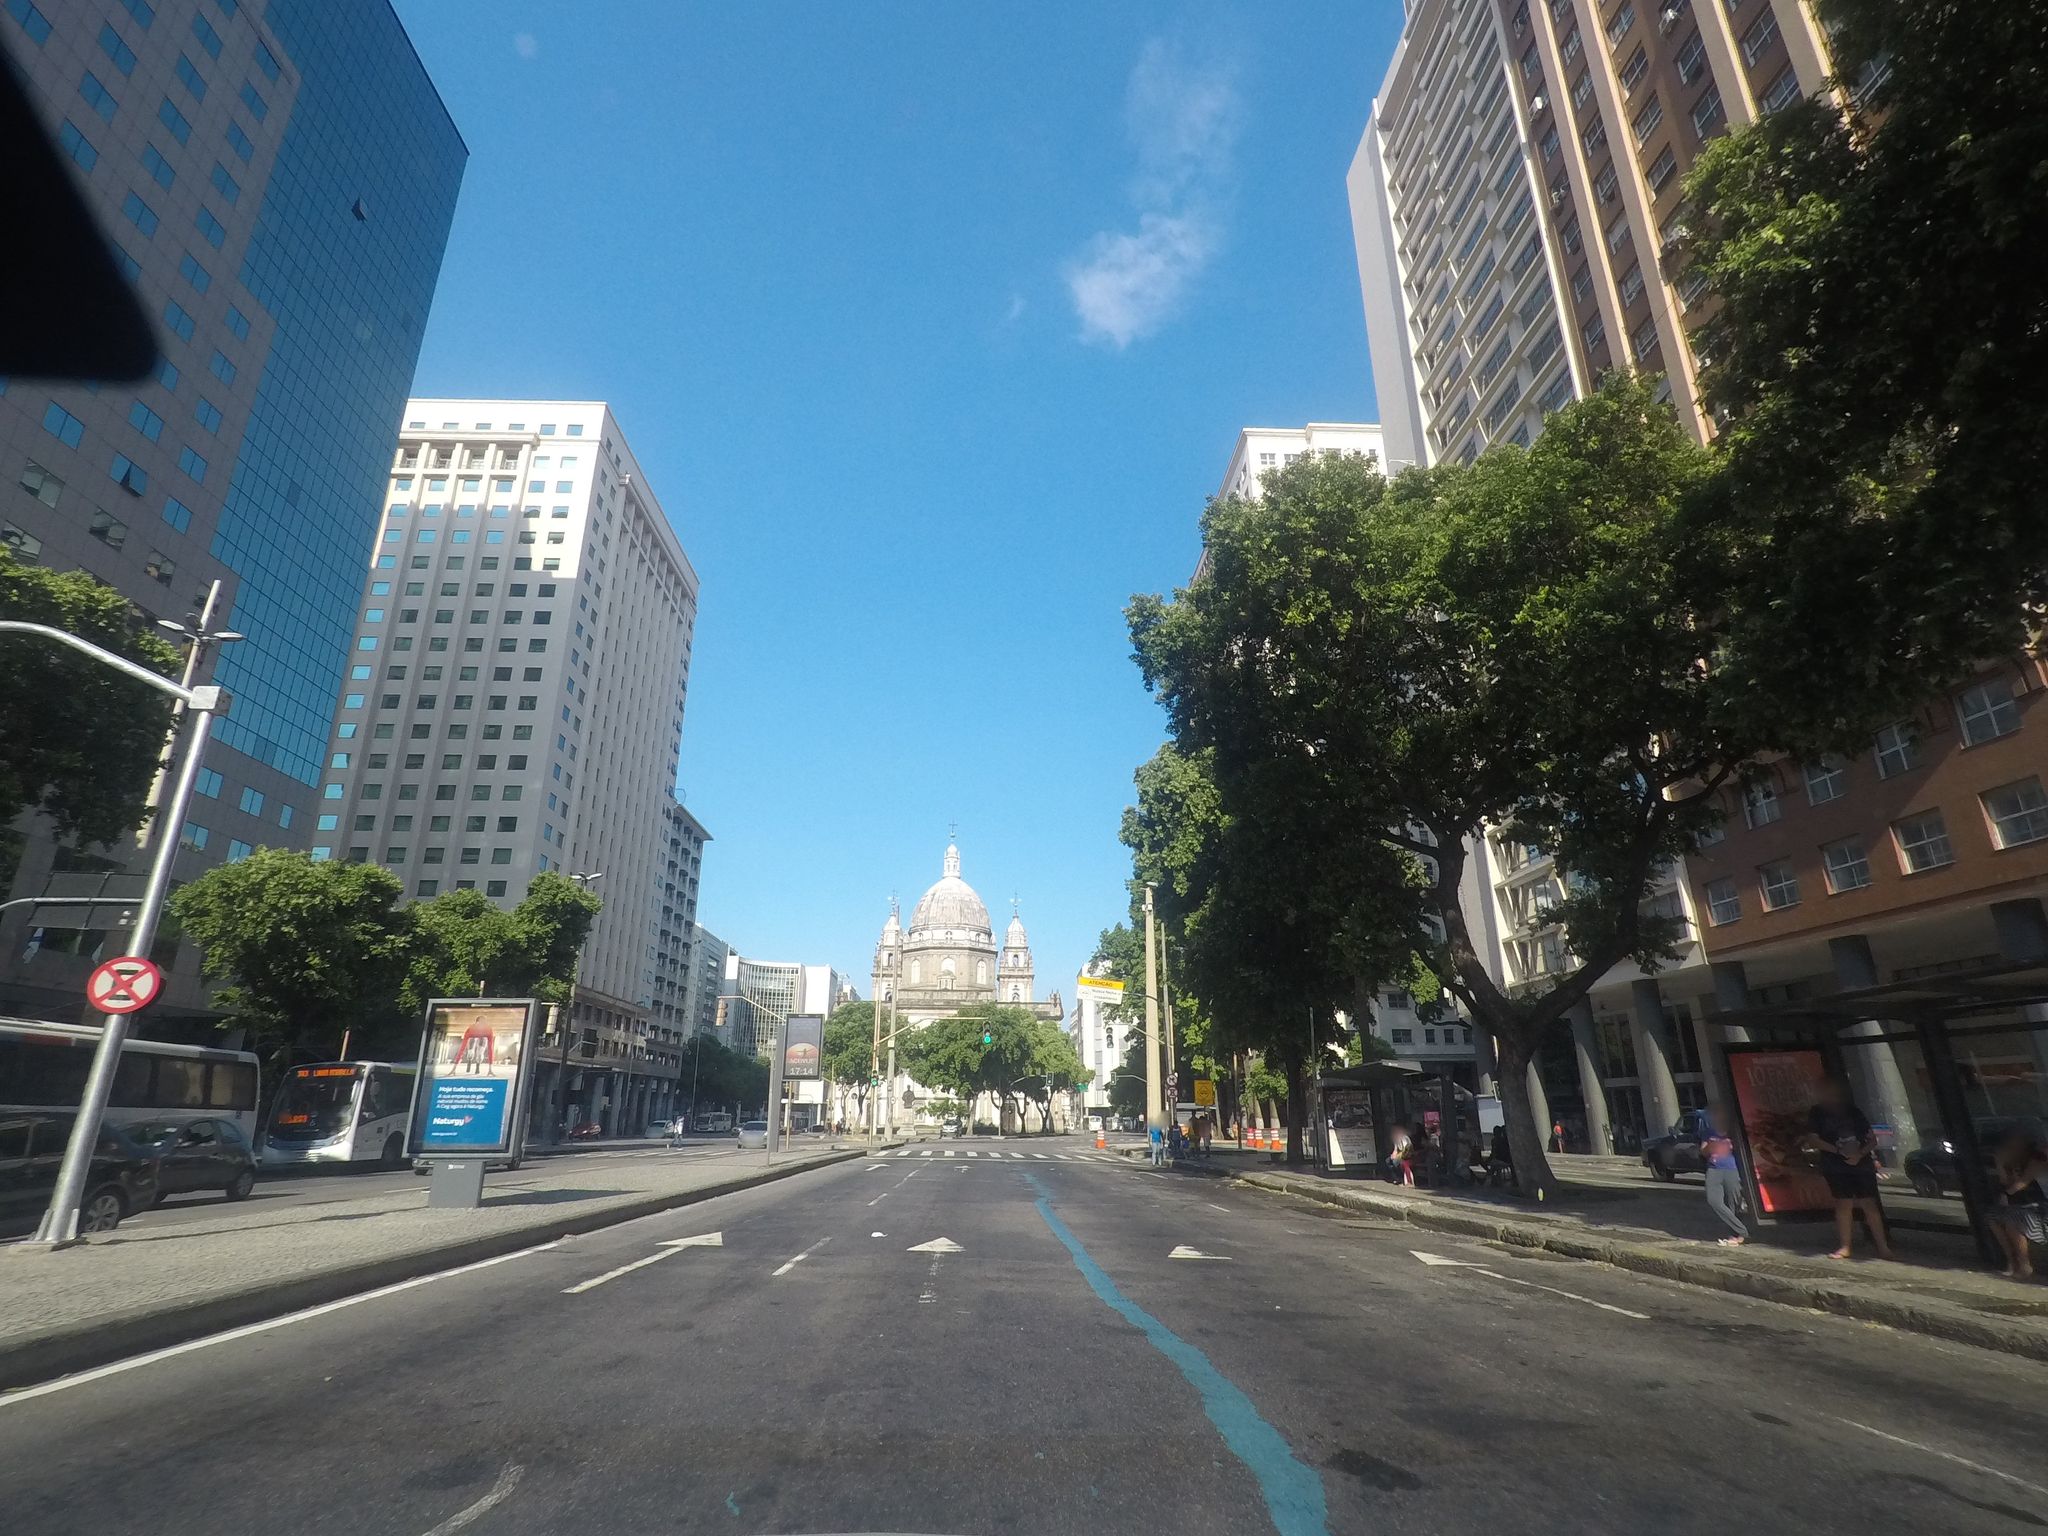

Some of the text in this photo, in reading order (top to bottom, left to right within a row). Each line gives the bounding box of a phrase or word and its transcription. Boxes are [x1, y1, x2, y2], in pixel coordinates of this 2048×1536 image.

[1088, 979, 1113, 987] ATENÇÃO
[790, 1067, 814, 1075] 17:14
[433, 1117, 465, 1126] Naturgy
